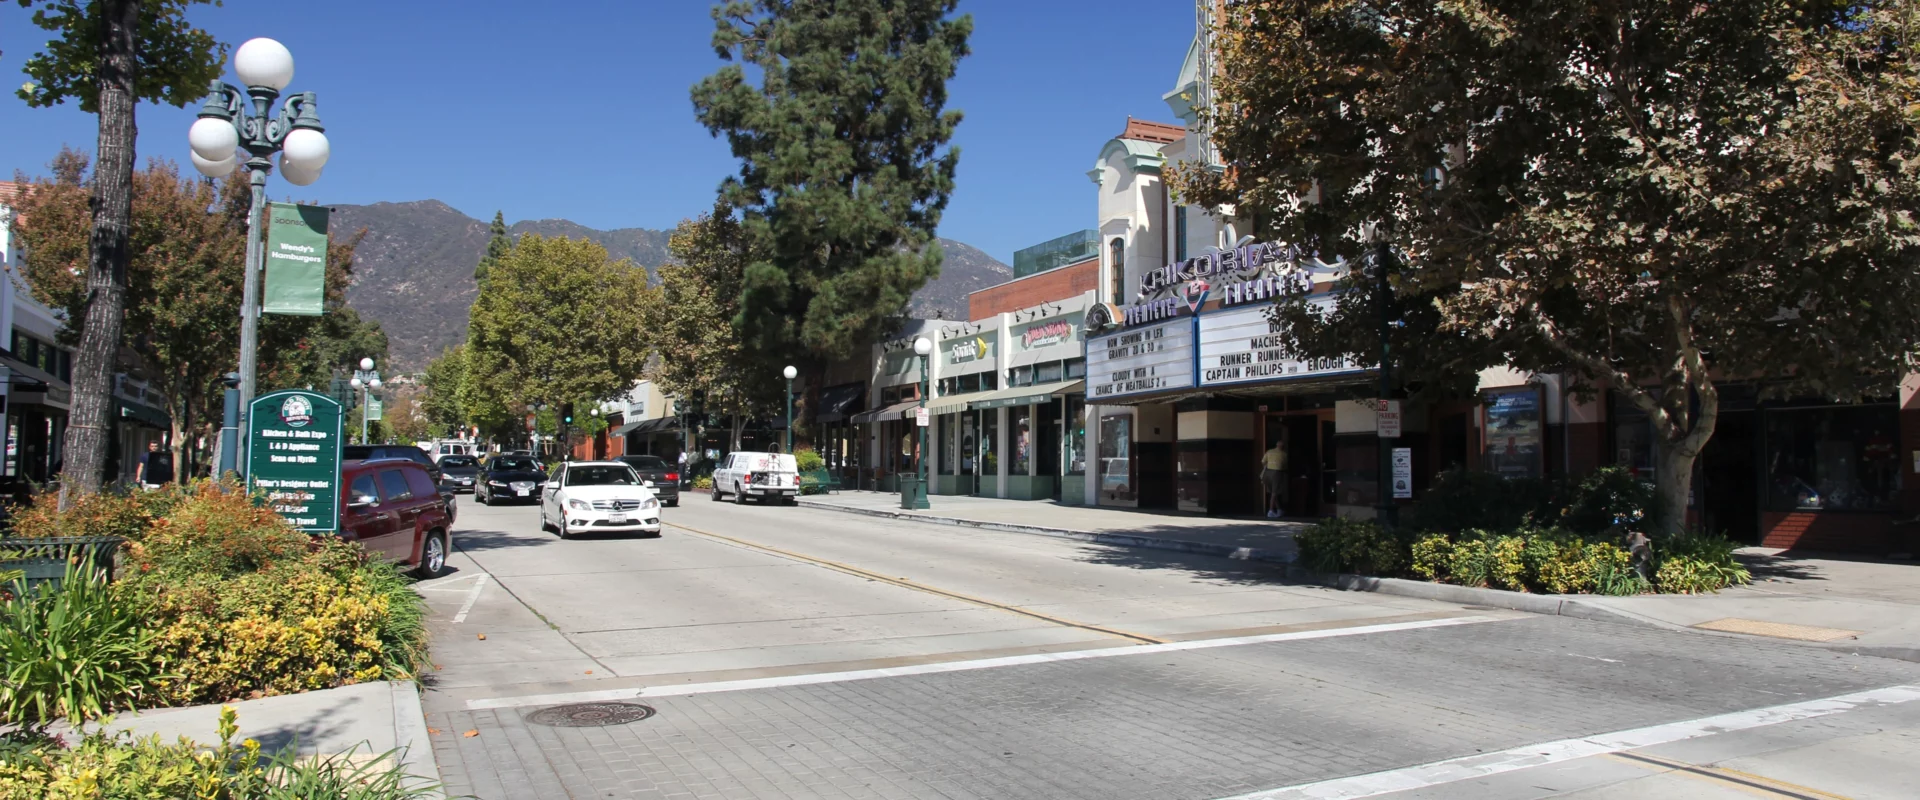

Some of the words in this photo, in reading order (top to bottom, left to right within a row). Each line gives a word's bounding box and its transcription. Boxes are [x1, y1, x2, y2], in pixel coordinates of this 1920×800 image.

[280, 243, 314, 253] Wendy's
[271, 251, 321, 263] Hamburgers
[1123, 299, 1174, 326] PREMIERE
[1107, 338, 1117, 348] NOW
[1121, 333, 1142, 345] SHOWING
[1251, 336, 1280, 350] MACHE
[1109, 347, 1129, 359] GRAVITY
[1220, 353, 1251, 367] RUNNER
[1258, 349, 1290, 362] RUNNER
[1112, 370, 1131, 382] CLOUDY
[1134, 367, 1147, 378] WITH
[1151, 366, 1155, 376] A
[1206, 367, 1240, 381] CAPTAIN
[1246, 363, 1283, 377] PHILLIPS
[1308, 356, 1344, 371] ENOUGH
[1095, 384, 1113, 396] CHANCE
[1116, 382, 1124, 392] OF
[1125, 378, 1154, 392] MEATBALLS
[1156, 377, 1160, 387] 2
[1378, 401, 1387, 411] NO
[1379, 412, 1398, 420] PARKING
[262, 429, 287, 437] Kitchen
[295, 430, 310, 438] Bath
[311, 431, 327, 439] Expo
[269, 442, 274, 450] L
[275, 442, 281, 450] &
[288, 443, 320, 451] Appliance
[297, 455, 317, 463] Myrtle
[281, 480, 308, 488] Designer
[309, 480, 329, 488] Outlet
